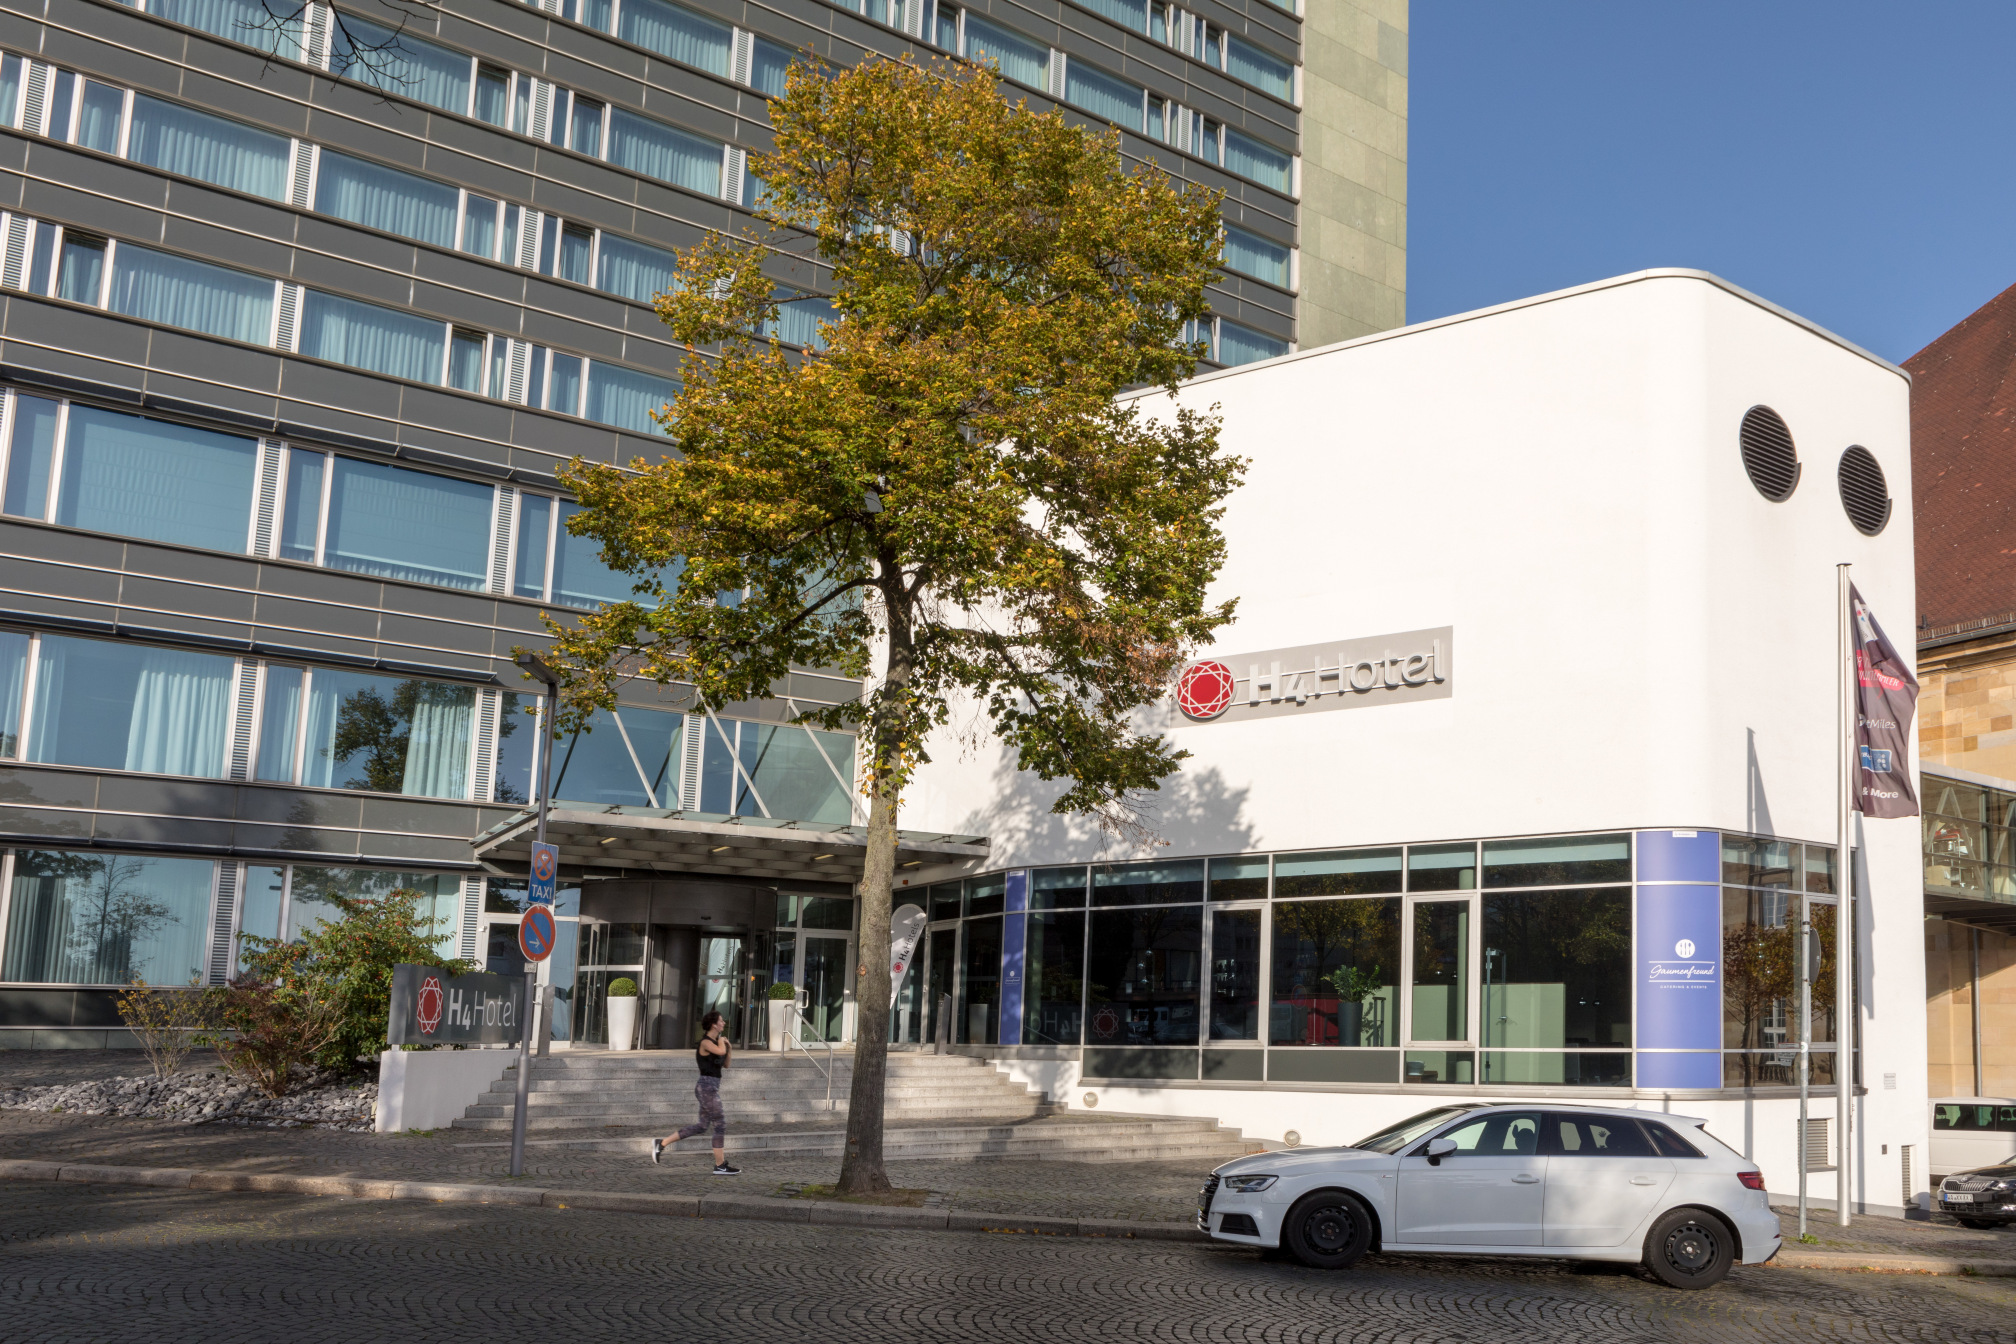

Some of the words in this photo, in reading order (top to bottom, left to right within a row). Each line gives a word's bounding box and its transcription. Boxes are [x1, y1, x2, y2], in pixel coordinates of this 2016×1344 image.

[1860, 716, 1896, 730] tMiles
[1862, 786, 1869, 796] &
[1870, 787, 1899, 799] More
[531, 883, 553, 900] TAXI
[1649, 964, 1715, 979] Gaumenfreund
